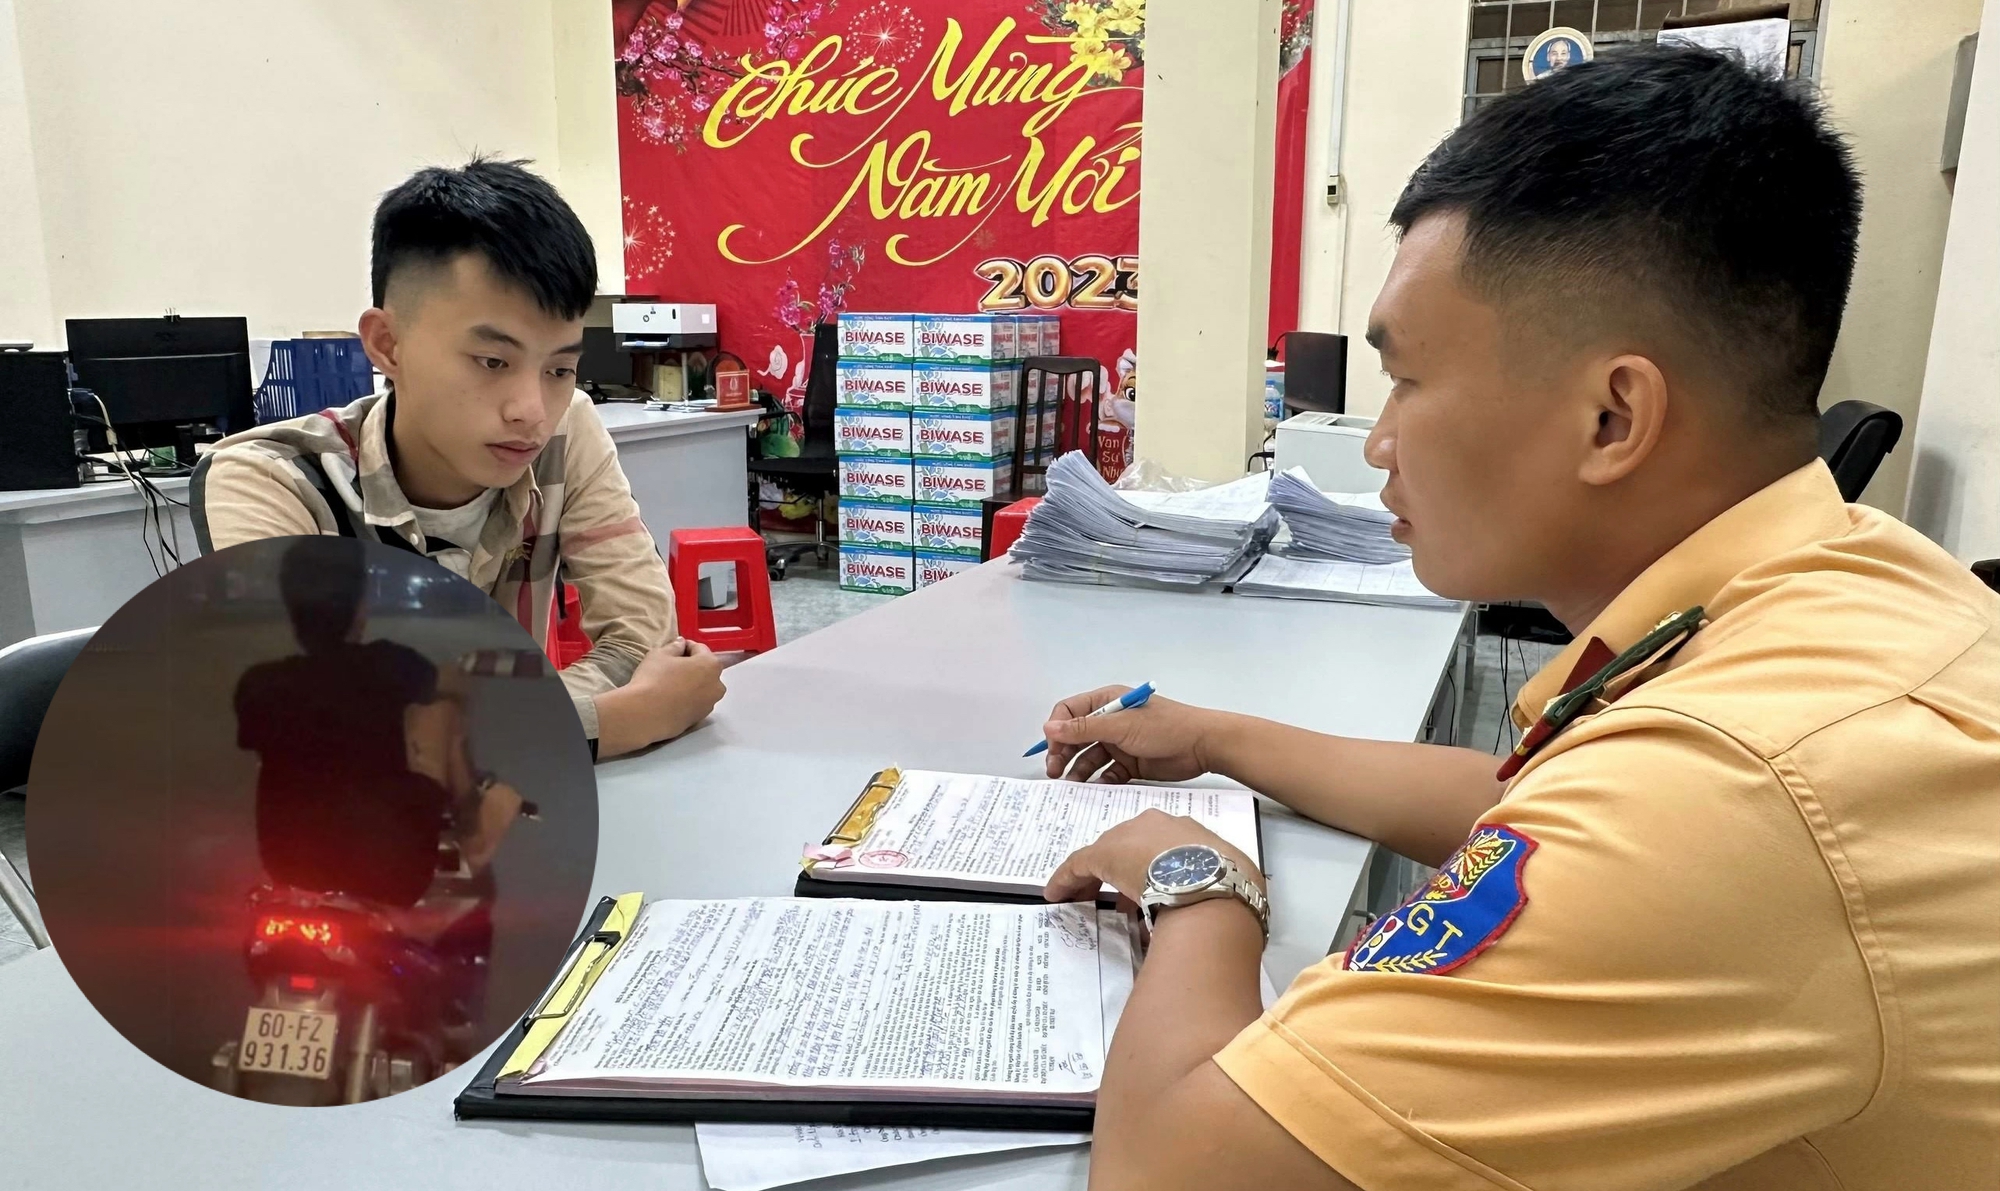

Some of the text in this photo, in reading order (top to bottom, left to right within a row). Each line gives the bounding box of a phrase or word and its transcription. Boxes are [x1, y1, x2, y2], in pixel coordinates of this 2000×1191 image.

[703, 35, 902, 148] Chúc
[845, 331, 905, 345] BIWASE
[921, 332, 985, 346] BIWASE
[845, 380, 906, 393] BIWASE
[920, 381, 983, 395] BIWASE
[842, 426, 903, 439] BIWASE
[920, 429, 984, 443] BIWASE
[847, 472, 905, 486] BIWASE
[922, 476, 986, 490] BIWASE
[846, 518, 905, 533] BIWASE
[921, 523, 982, 538] BIWASE
[847, 563, 905, 578] BIWASE
[259, 1012, 323, 1042] 60-F2
[244, 1041, 328, 1073] 931.36
